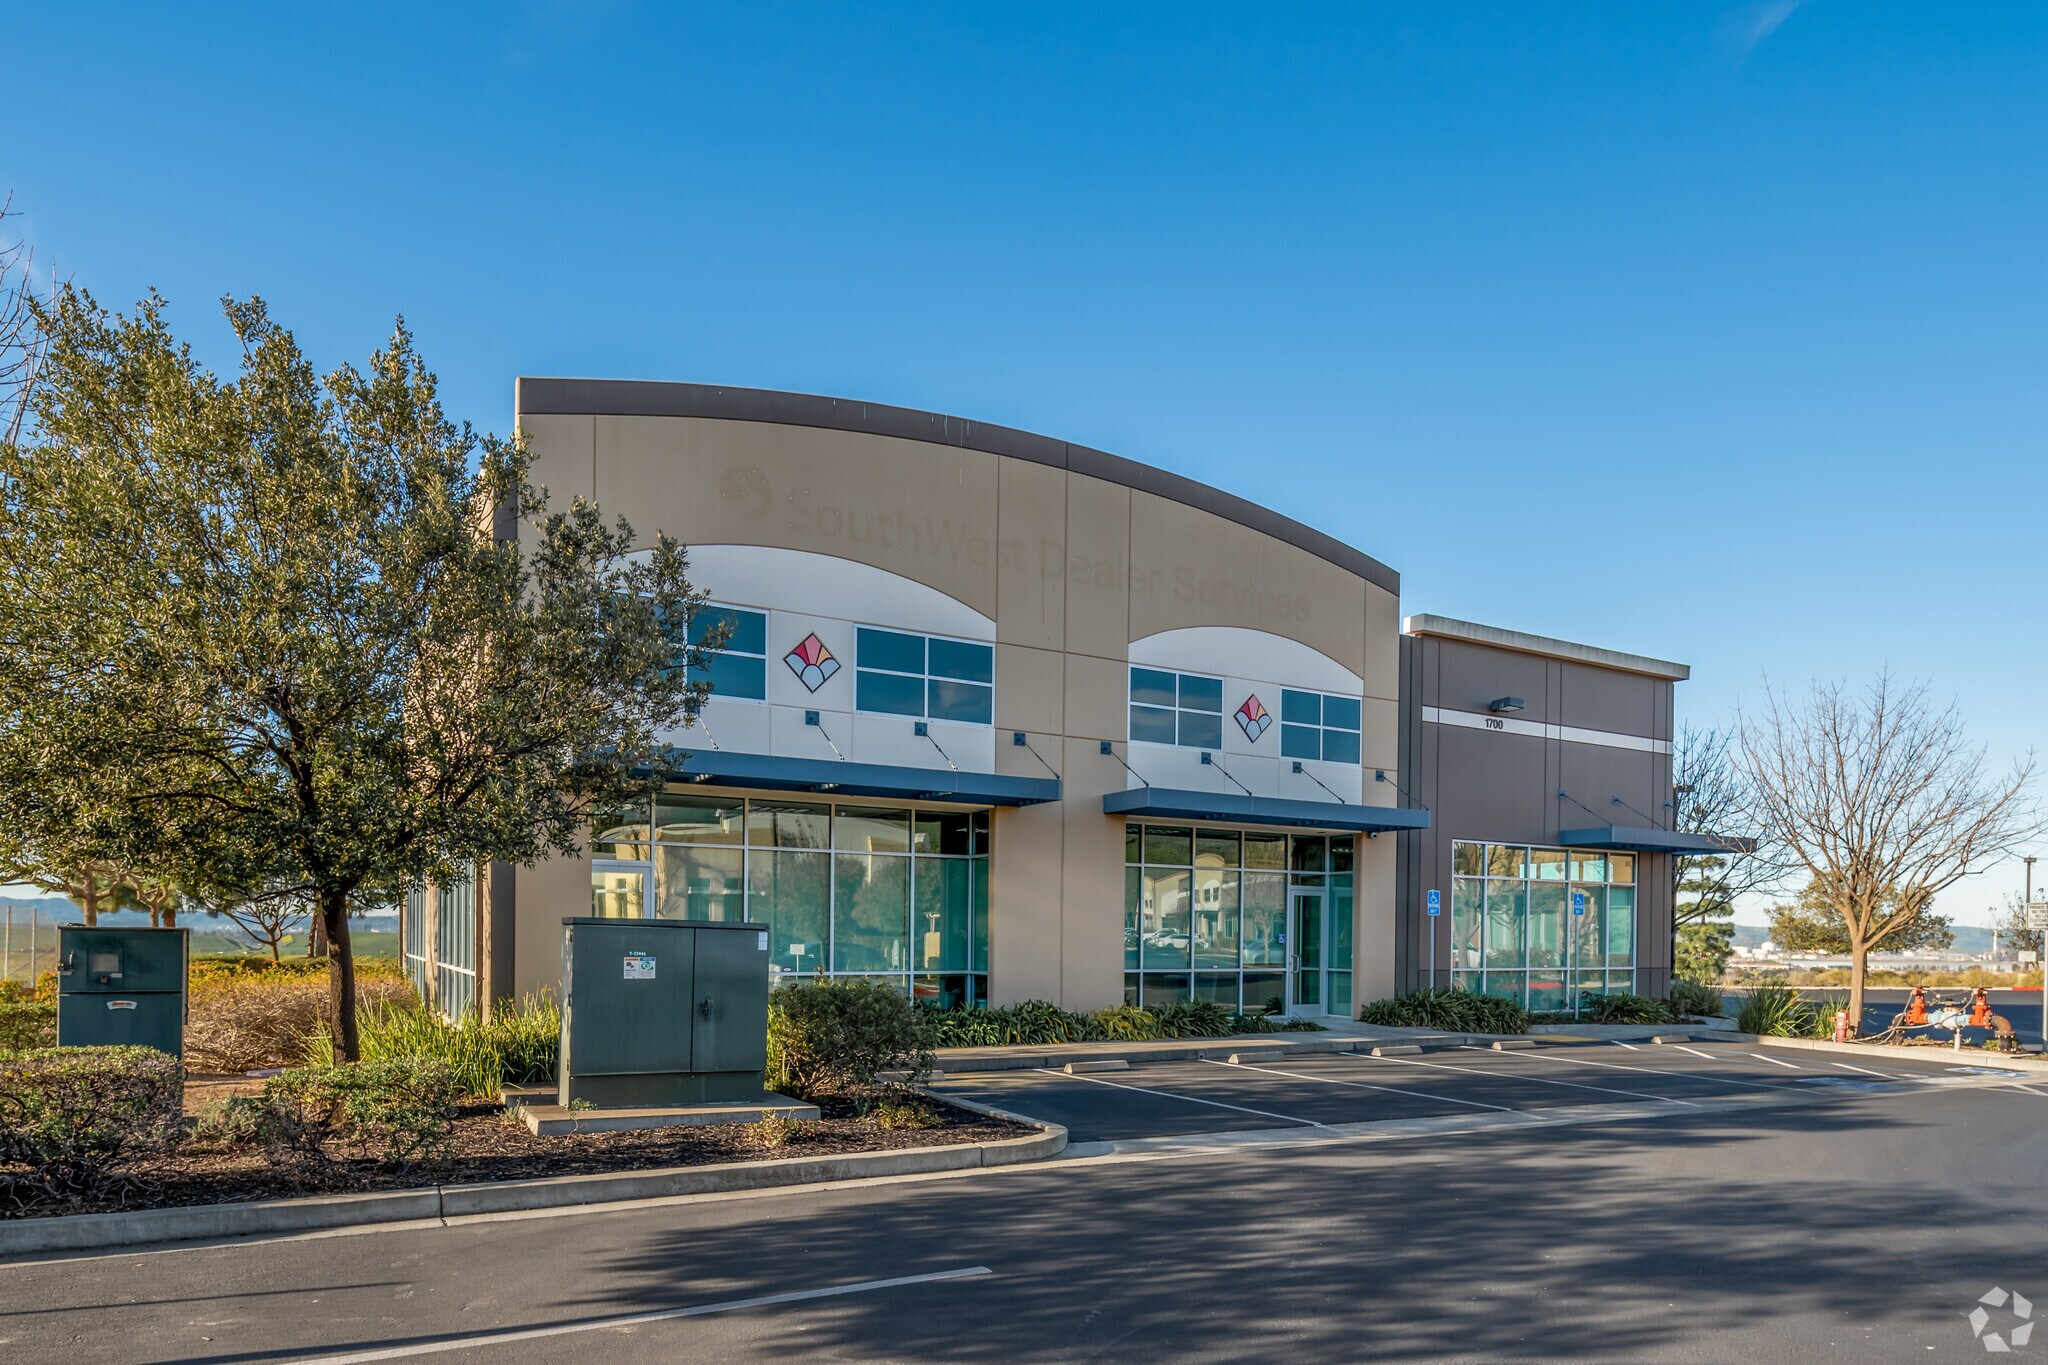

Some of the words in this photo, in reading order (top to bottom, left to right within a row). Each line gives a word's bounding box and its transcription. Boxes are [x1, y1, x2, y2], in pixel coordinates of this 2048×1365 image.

[785, 487, 1026, 572] SouthWest
[1040, 538, 1160, 593] Dealer
[1174, 566, 1310, 621] Services
[1485, 718, 1503, 730] 1700
